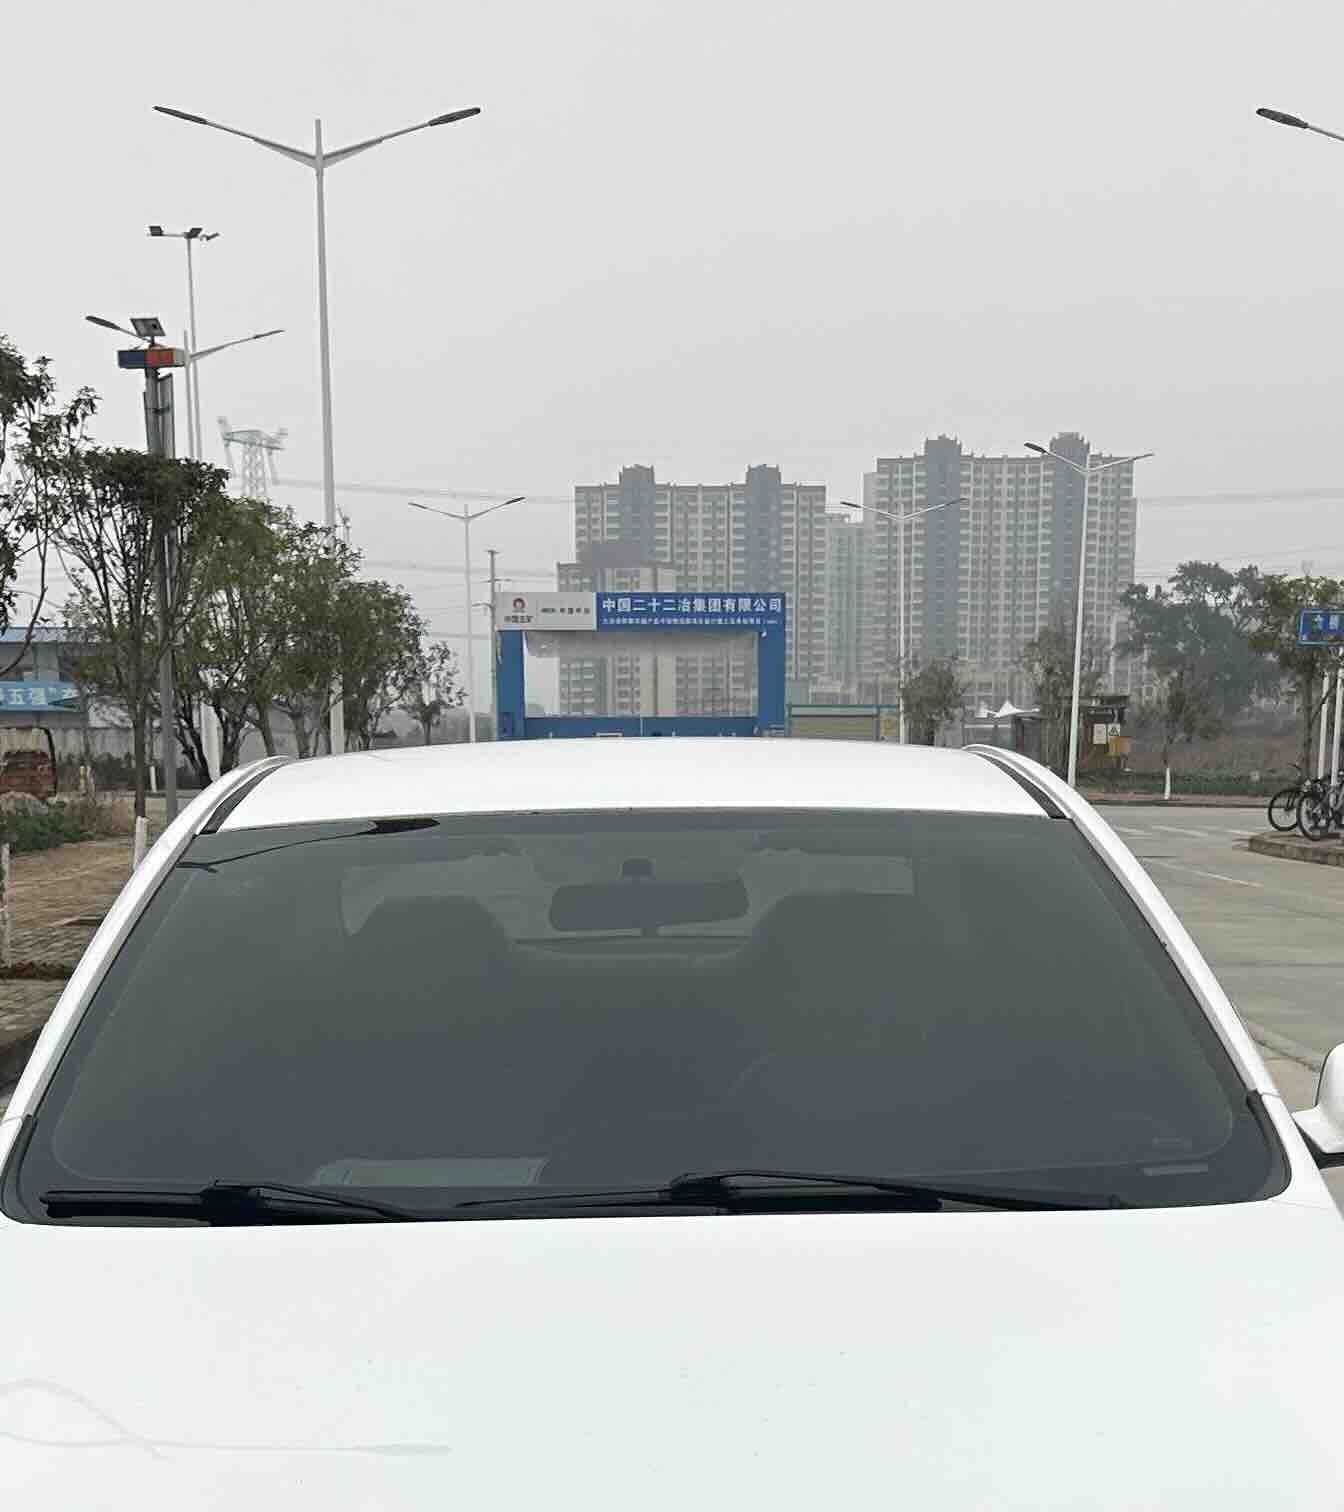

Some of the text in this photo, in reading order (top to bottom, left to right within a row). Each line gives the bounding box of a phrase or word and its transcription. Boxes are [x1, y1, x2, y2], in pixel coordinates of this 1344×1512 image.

[602, 597, 782, 613] 中国二十二冶集团有限公司
